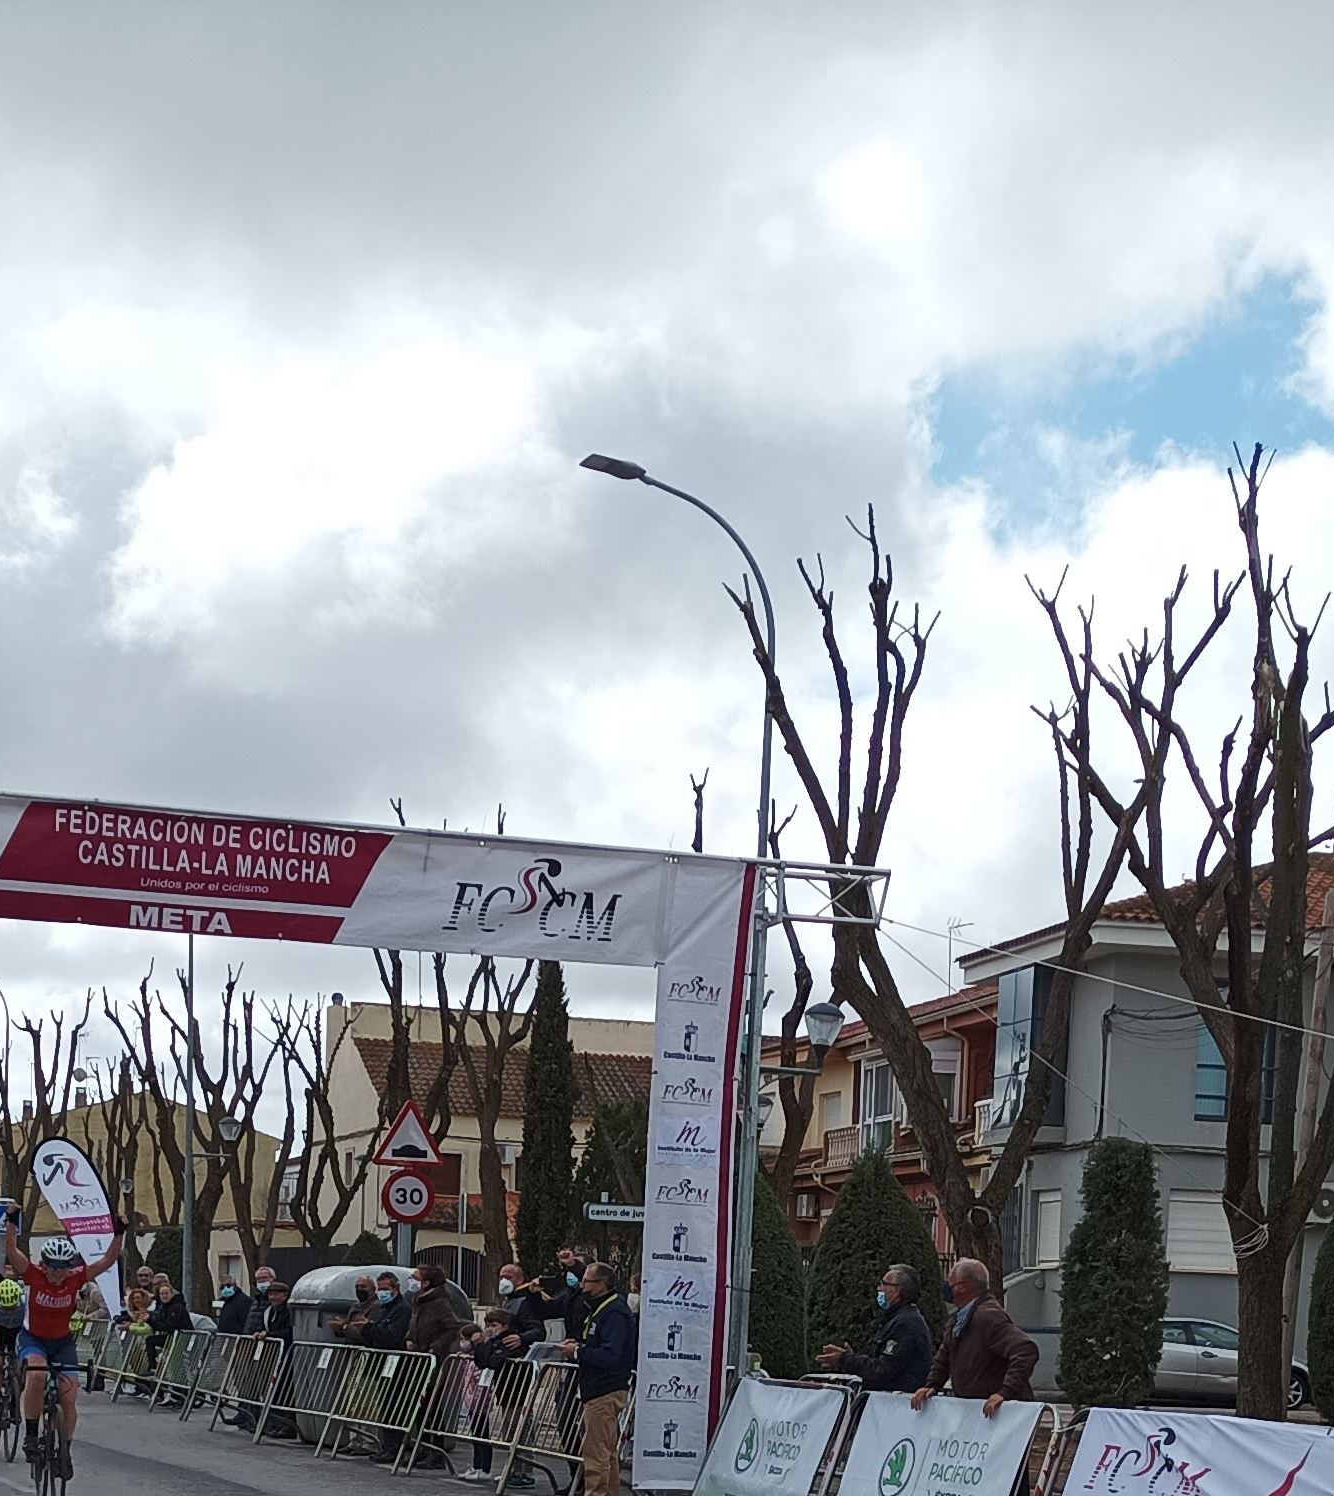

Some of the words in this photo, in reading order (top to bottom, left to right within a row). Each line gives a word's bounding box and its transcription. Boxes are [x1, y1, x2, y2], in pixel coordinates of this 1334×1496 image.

[54, 807, 205, 845] FEDERACIÓN
[212, 824, 243, 849] DE
[249, 826, 357, 858] CICLISMO
[77, 840, 230, 876] CASTILLA-LA
[235, 854, 331, 885] MANCHA
[140, 877, 183, 890] Unidos
[184, 881, 207, 893] por
[208, 881, 221, 892] el
[222, 882, 270, 895] ciclismo
[129, 904, 234, 935] META
[395, 1187, 424, 1206] 30
[590, 1208, 618, 1217] centro
[619, 1209, 630, 1217] de
[936, 1439, 989, 1461] MOTOR
[928, 1460, 983, 1486] PACÍFICO
